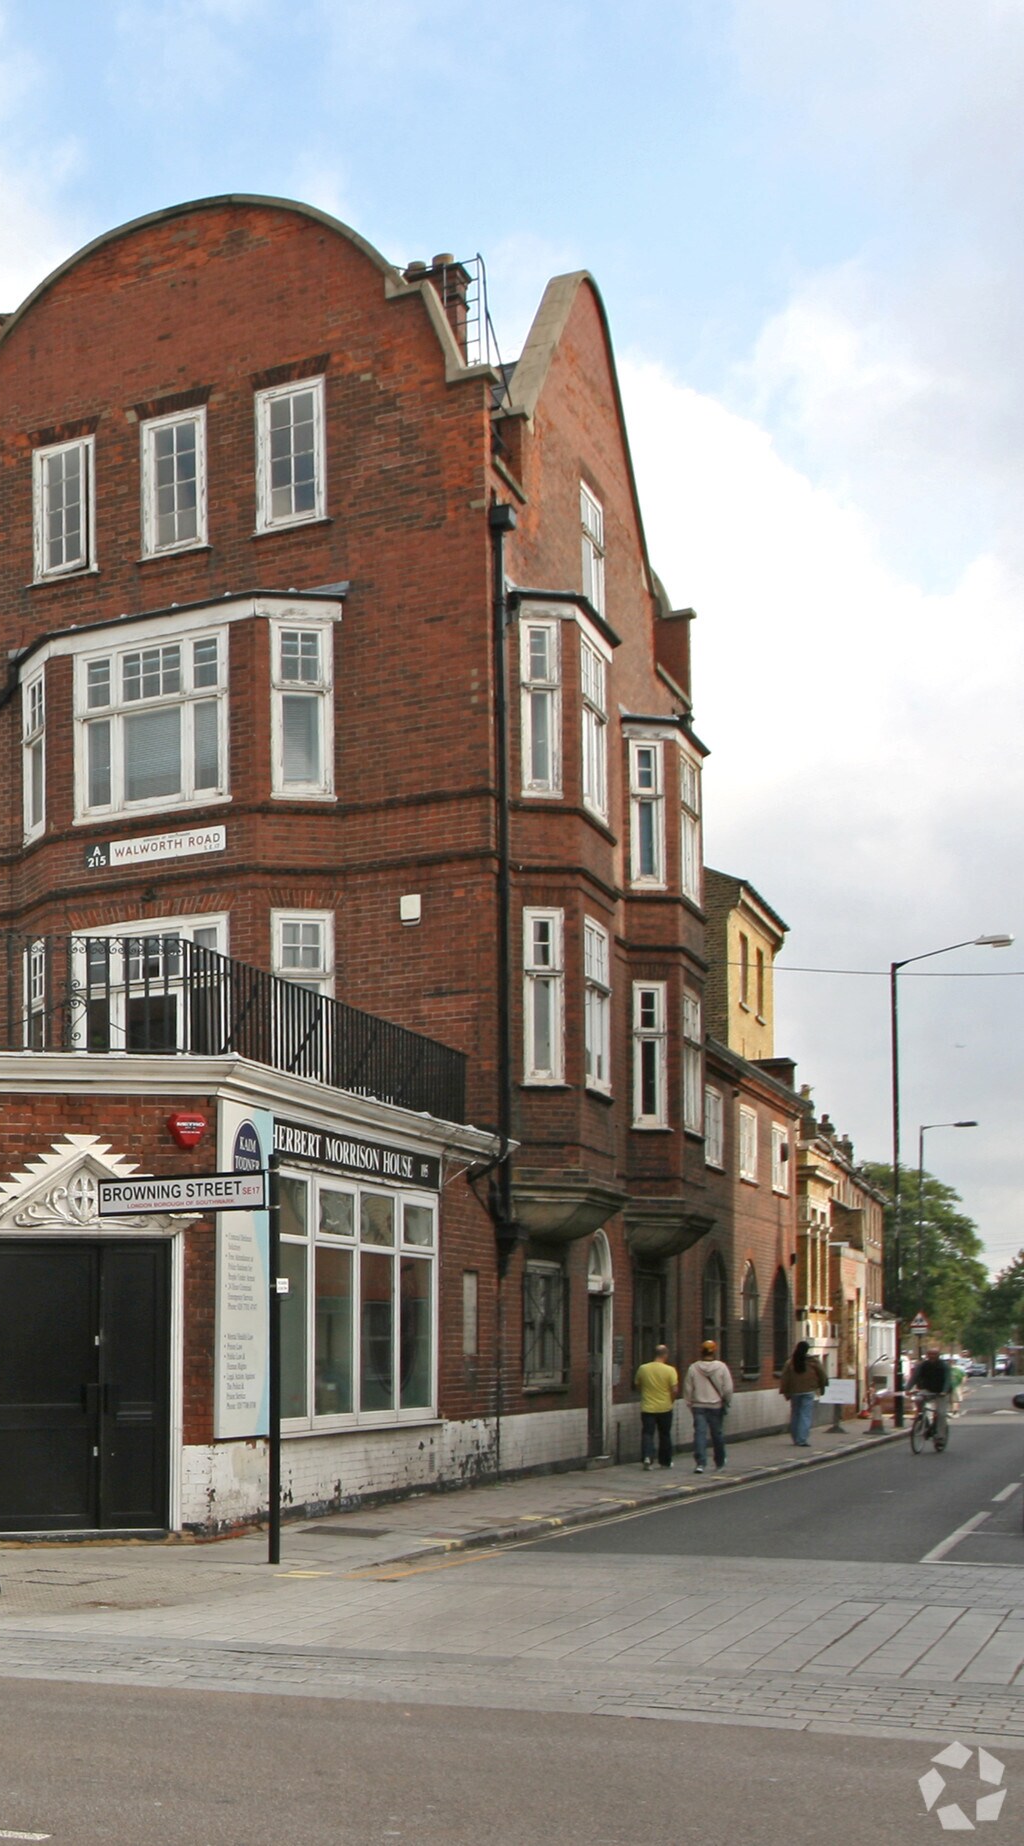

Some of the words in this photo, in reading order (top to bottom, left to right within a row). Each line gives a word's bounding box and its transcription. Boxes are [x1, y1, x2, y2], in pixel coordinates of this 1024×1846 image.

[93, 846, 101, 856] A
[115, 839, 183, 857] WALWORTH
[188, 833, 221, 847] ROAD
[87, 856, 106, 868] 215
[239, 1136, 256, 1153] KAIM
[325, 1137, 380, 1171] MORRISON
[383, 1151, 414, 1179] HOUSE
[103, 1183, 181, 1202] BROWNING
[185, 1180, 242, 1197] STREET
[242, 1186, 260, 1195] SE17
[195, 1198, 235, 1206] SOUTHWARK
